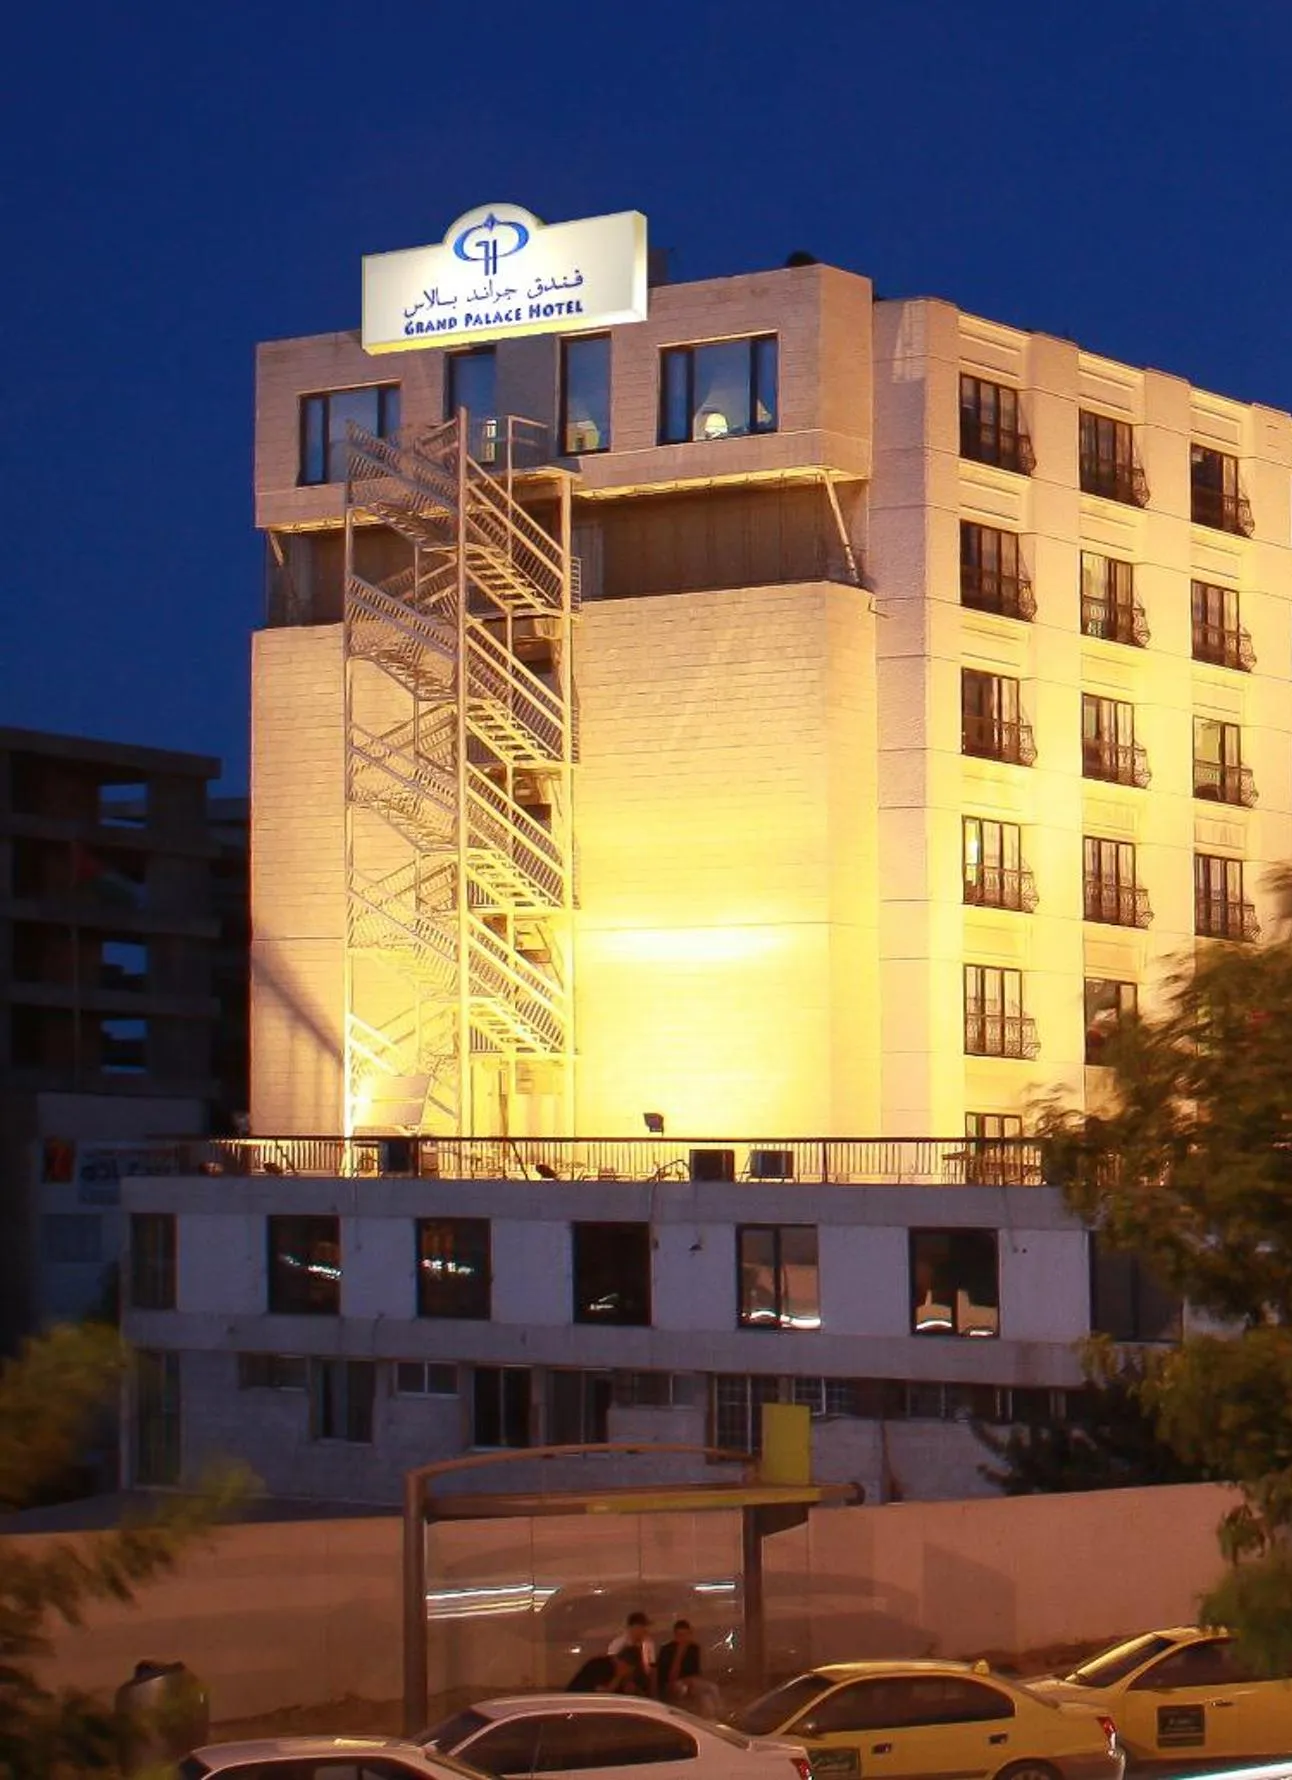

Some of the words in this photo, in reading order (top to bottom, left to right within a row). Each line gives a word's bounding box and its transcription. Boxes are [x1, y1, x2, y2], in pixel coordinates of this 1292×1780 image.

[467, 279, 517, 303] جراند
[527, 269, 583, 299] فندق
[404, 286, 457, 318] بالاس
[404, 317, 458, 335] GRAND
[464, 307, 522, 328] PALACE
[528, 300, 583, 319] HOTEL
